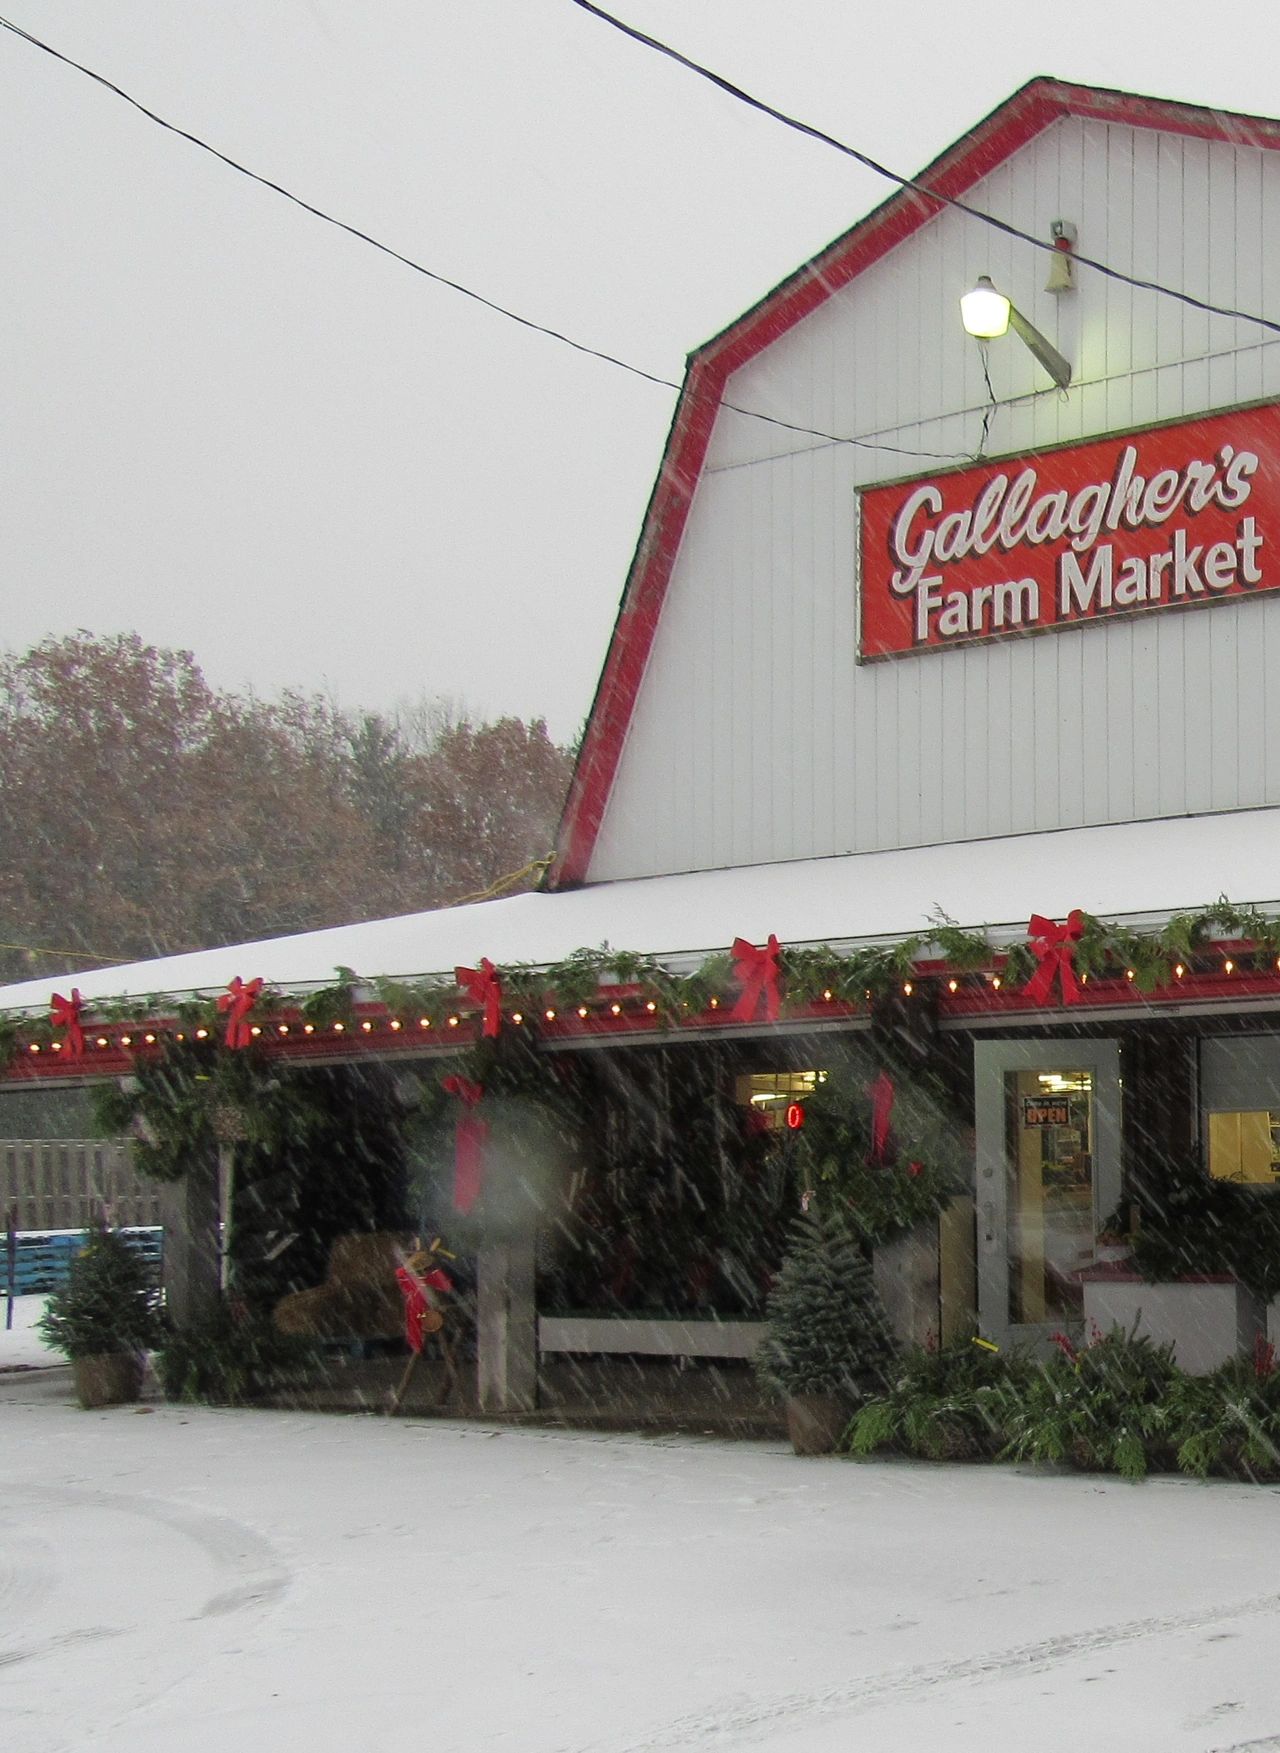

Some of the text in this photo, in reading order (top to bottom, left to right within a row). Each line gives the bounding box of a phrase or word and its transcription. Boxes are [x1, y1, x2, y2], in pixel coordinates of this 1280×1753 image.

[891, 445, 1259, 594] Gallagher's
[916, 517, 1264, 641] Farm Market
[1027, 1107, 1067, 1123] OPEN
